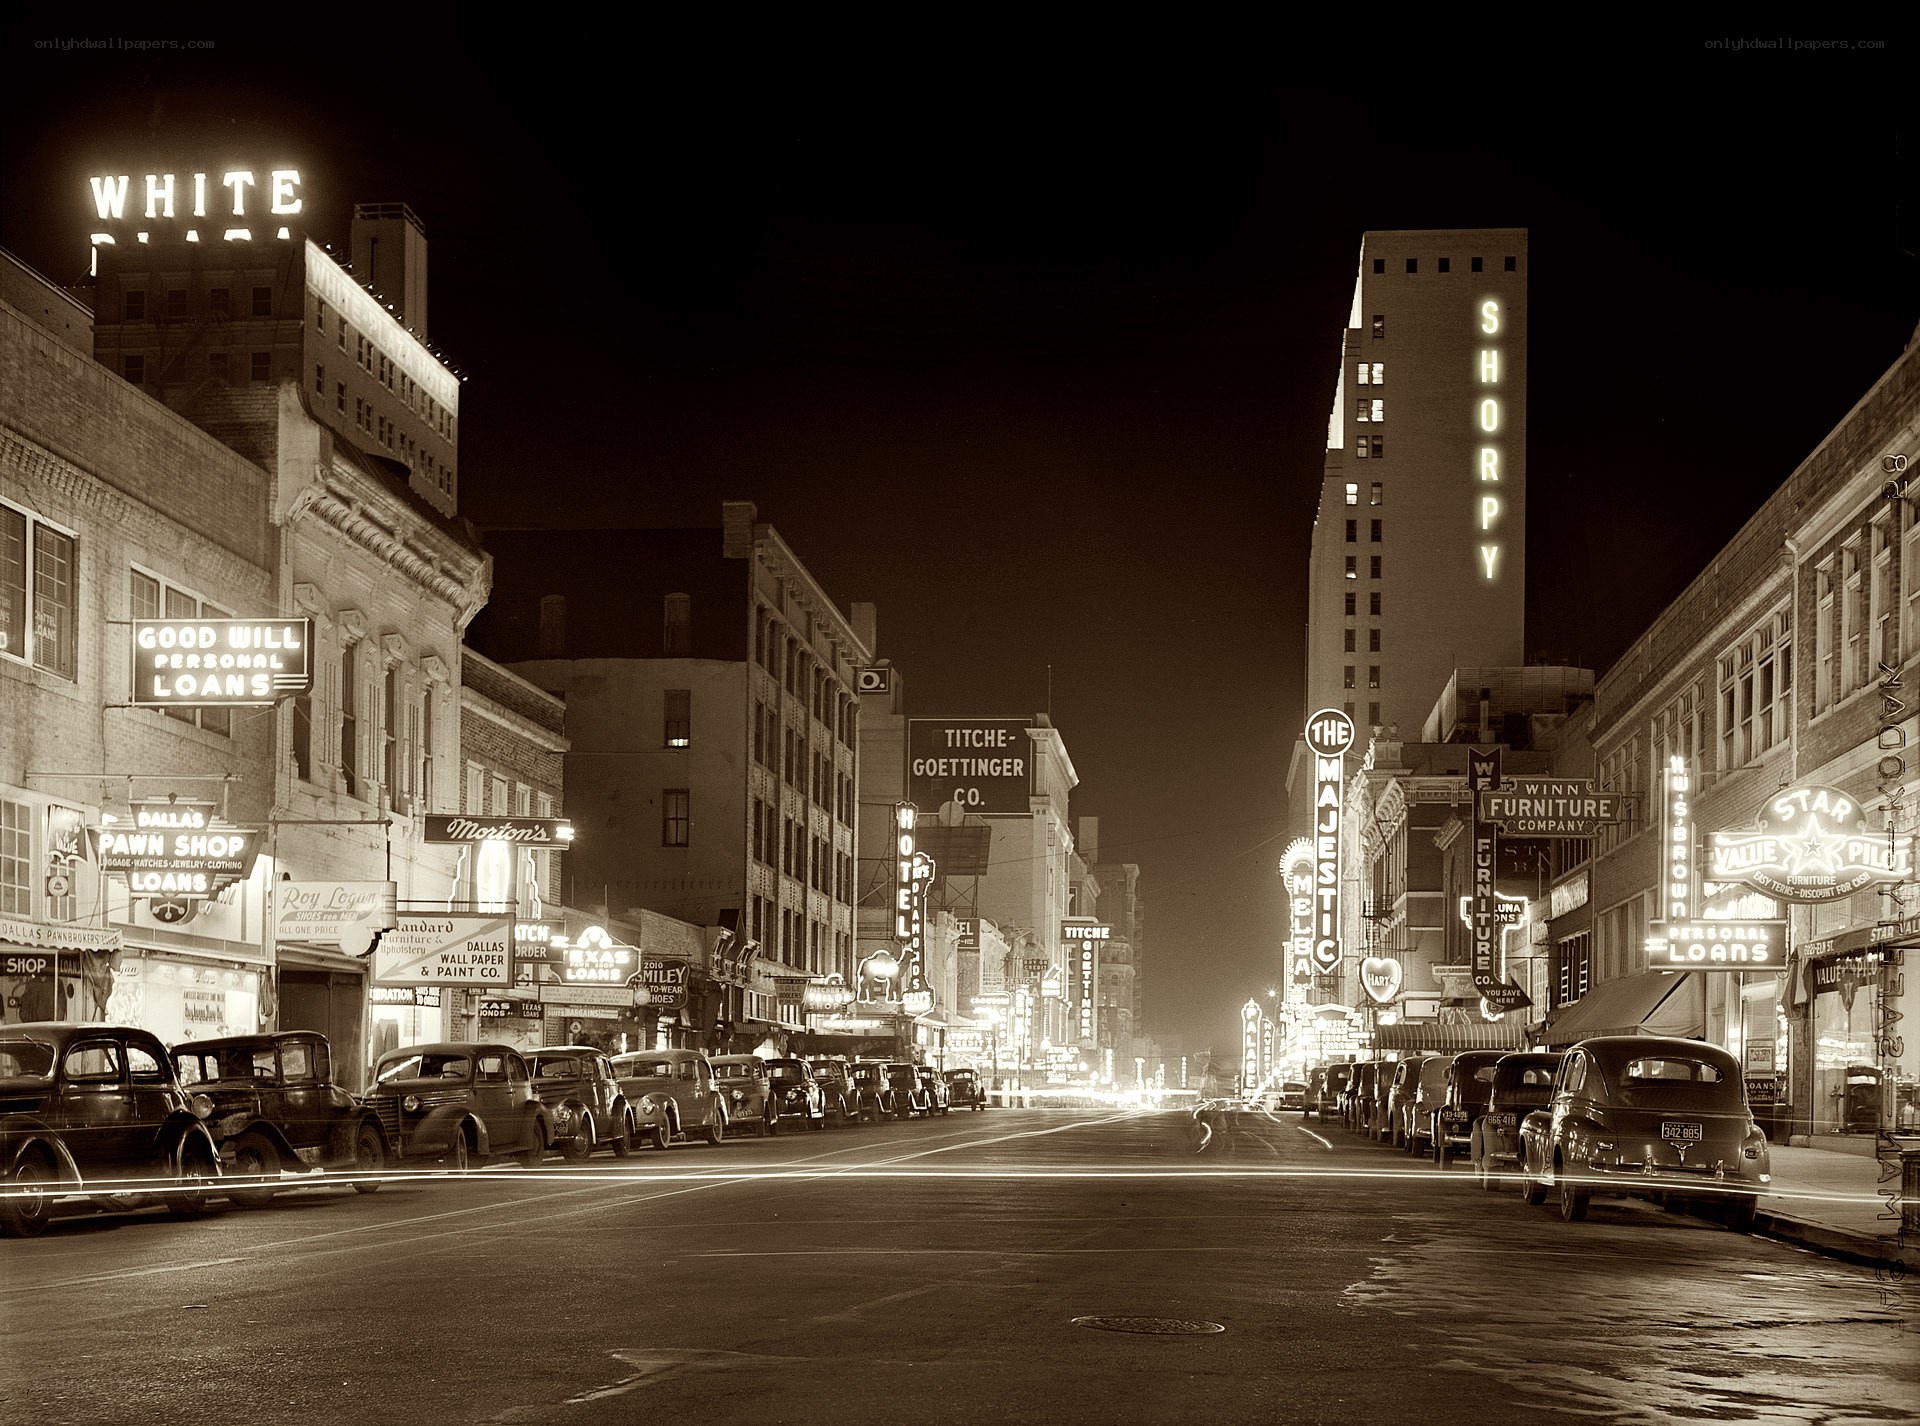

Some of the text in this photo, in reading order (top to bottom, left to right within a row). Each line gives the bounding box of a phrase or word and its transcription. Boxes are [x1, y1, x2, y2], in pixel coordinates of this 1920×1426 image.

[90, 169, 302, 218] WHITE
[1480, 300, 1500, 580] SHORPY
[138, 626, 301, 649] GOOD WILL
[154, 653, 284, 669] PERSONAL
[153, 674, 270, 697] LOANS
[1311, 720, 1350, 746] THE
[912, 758, 1024, 777] GOETTINGER
[953, 787, 986, 806] CO.
[1525, 783, 1579, 795] WINN
[1490, 798, 1611, 818] FURNITURE
[1774, 790, 1852, 823] STAR
[138, 811, 205, 829] DALLAS
[1518, 820, 1585, 832] COMPANY
[446, 817, 551, 842] Morton's
[100, 833, 245, 857] PAWN SHOP
[1317, 758, 1339, 963] MAJESTIC
[1714, 840, 1911, 870] VALUE PILOT
[134, 859, 168, 868] WATCHES
[170, 859, 205, 869] JEWELRY
[207, 860, 243, 870] CLOTHING
[899, 808, 914, 937] HOTEL
[131, 871, 208, 892] LOANS
[1752, 870, 1773, 887] EASY
[1837, 882, 1852, 895] FOR
[1853, 871, 1872, 888] CASH
[1786, 875, 1837, 886] FURNITURE
[282, 886, 377, 911] Roy Logan
[1476, 839, 1491, 970] FURNITURE
[296, 911, 322, 921] SHOES
[340, 911, 359, 921] MEN
[2, 922, 42, 940] DALLAS
[47, 929, 100, 944] PAWNBROKERS
[280, 925, 339, 935] ALL ONE PRICE
[395, 920, 454, 933] tandard
[514, 924, 551, 942] ATCH
[956, 921, 974, 936] EL
[1064, 926, 1110, 939] TITCHE
[1292, 874, 1313, 977] MELBA
[1669, 927, 1769, 941] PERSONAL
[1870, 925, 1895, 942] STAR
[383, 934, 431, 944] Furniture
[911, 881, 920, 991] DIAMONDS
[380, 944, 426, 956] Upholstery
[467, 941, 505, 952] DALLAS
[1669, 943, 1769, 962] LOANS
[440, 954, 505, 966] WALL PAPER
[564, 949, 630, 964] TEXAS
[5, 957, 47, 974] SHOP
[420, 966, 501, 978] & PAINT CO.
[566, 968, 621, 981] LOANS
[1475, 975, 1494, 985] CO.
[1816, 965, 1842, 986] VALUE
[1081, 940, 1092, 1037] GOETTINGER
[1485, 989, 1521, 997] YOU SAVE
[521, 1003, 542, 1012] TEXAS
[650, 994, 674, 1004] HOES
[809, 1002, 840, 1010] SHOP
[523, 1010, 540, 1018] LOANS
[566, 1008, 600, 1018] BARGAINS
[1245, 1007, 1257, 1088] PALACE
